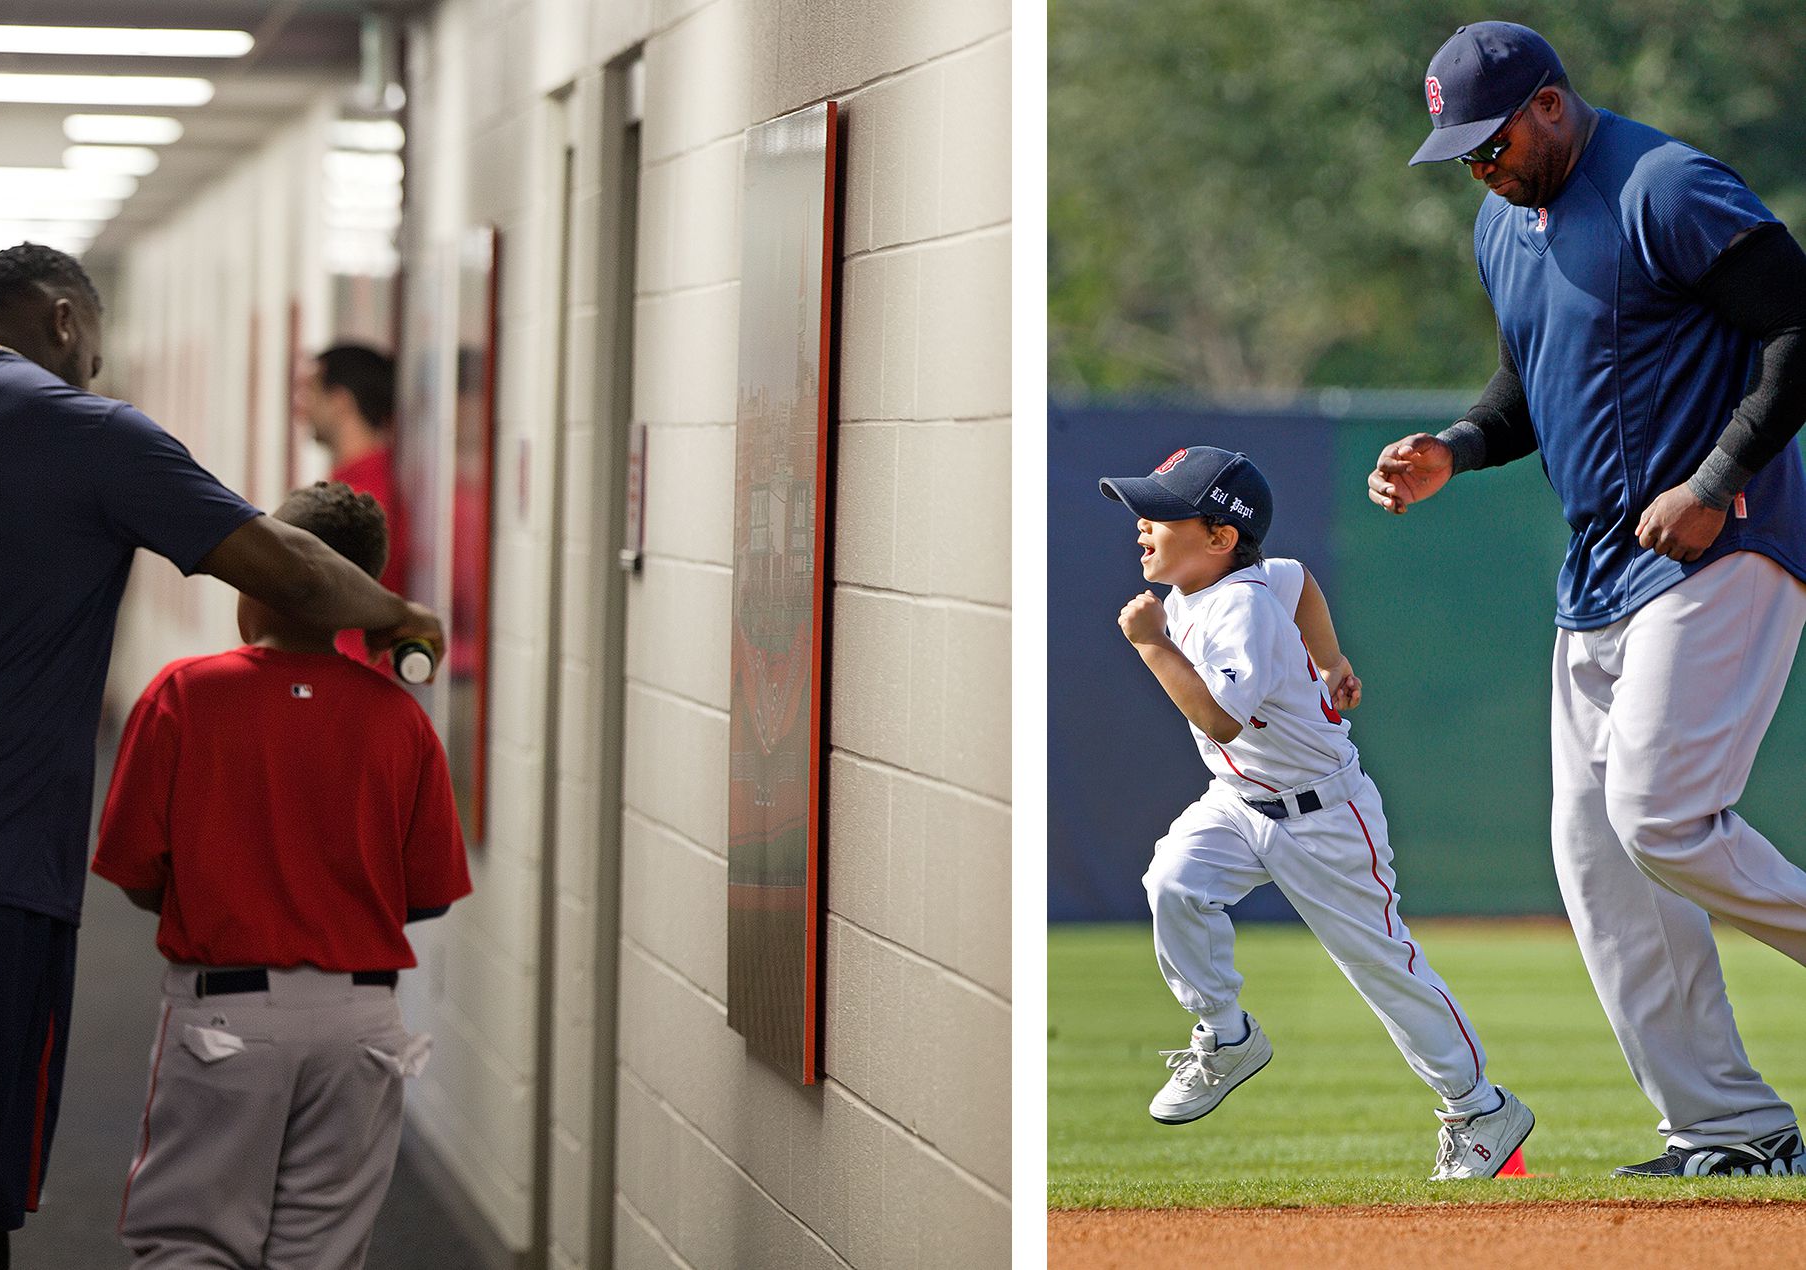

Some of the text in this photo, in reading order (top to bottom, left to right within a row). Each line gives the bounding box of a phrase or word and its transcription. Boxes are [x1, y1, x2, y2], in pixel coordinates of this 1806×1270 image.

[1425, 76, 1444, 115] B
[1536, 207, 1548, 231] B
[1154, 448, 1189, 475] B
[1210, 487, 1254, 519] Lil Papi
[1472, 1143, 1491, 1161] B
